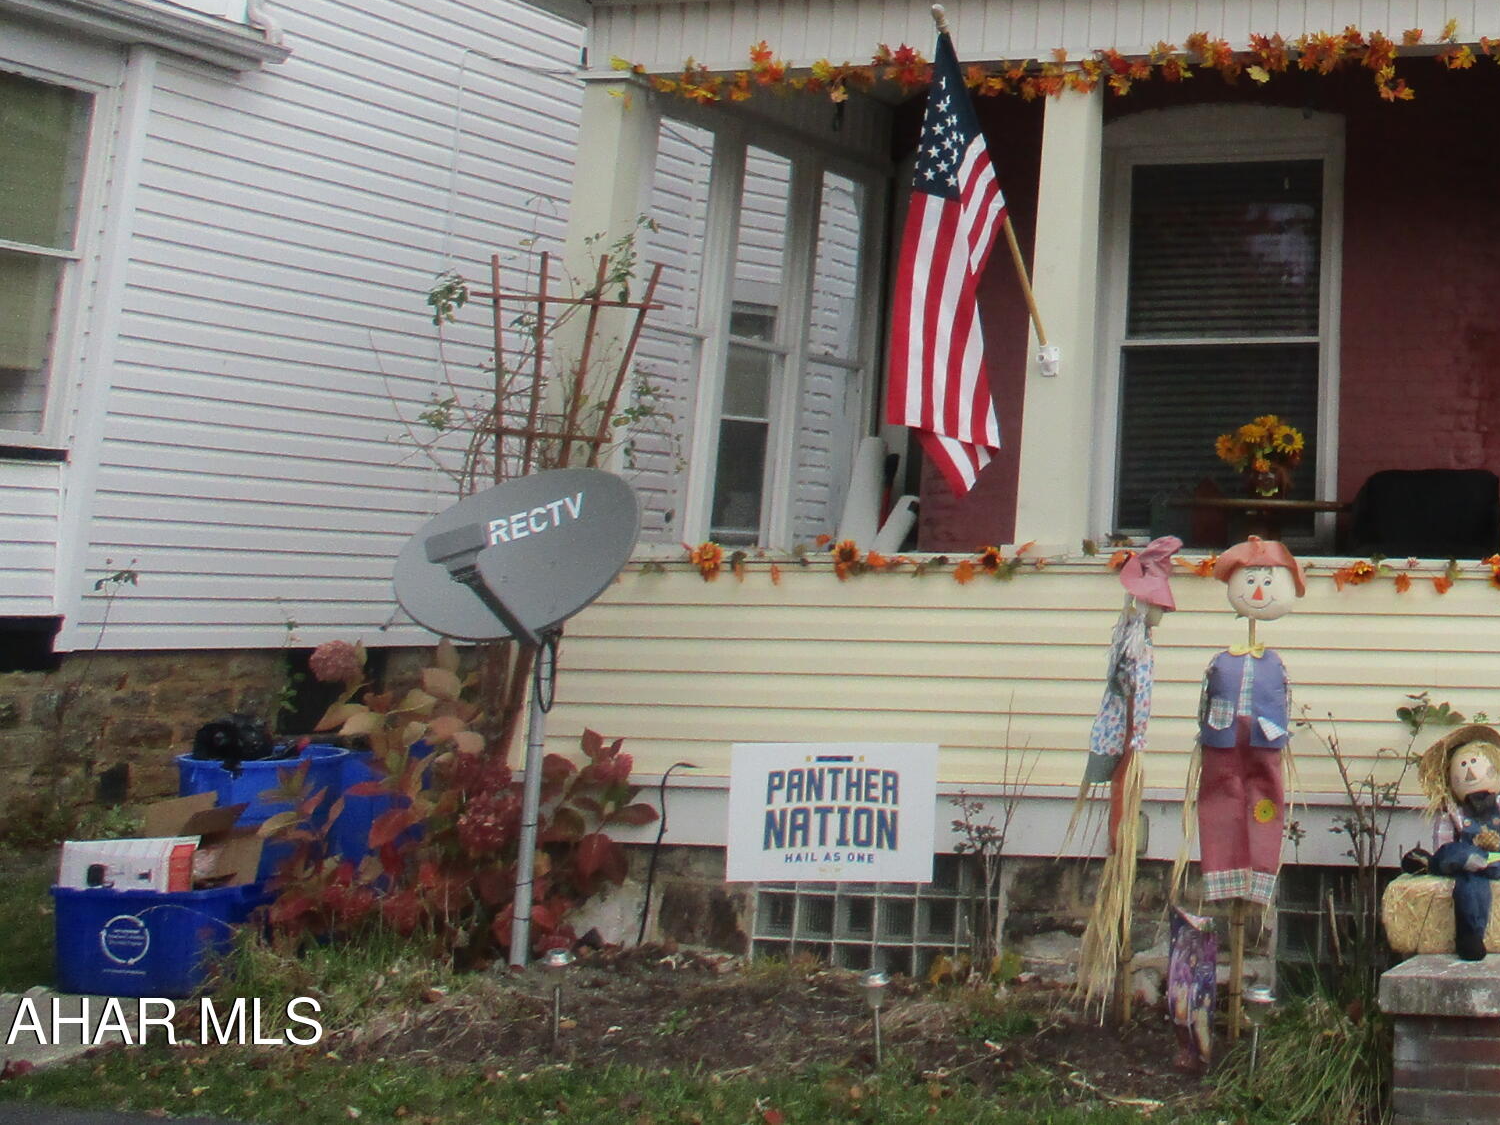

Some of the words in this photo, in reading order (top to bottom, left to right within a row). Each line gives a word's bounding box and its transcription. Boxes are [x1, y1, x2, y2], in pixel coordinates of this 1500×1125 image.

[488, 491, 584, 546] RECTV
[766, 767, 899, 805] PANTHER
[763, 806, 898, 850] NATION
[785, 853, 818, 863] HAIL
[823, 853, 841, 862] AS
[847, 853, 875, 863] ONE
